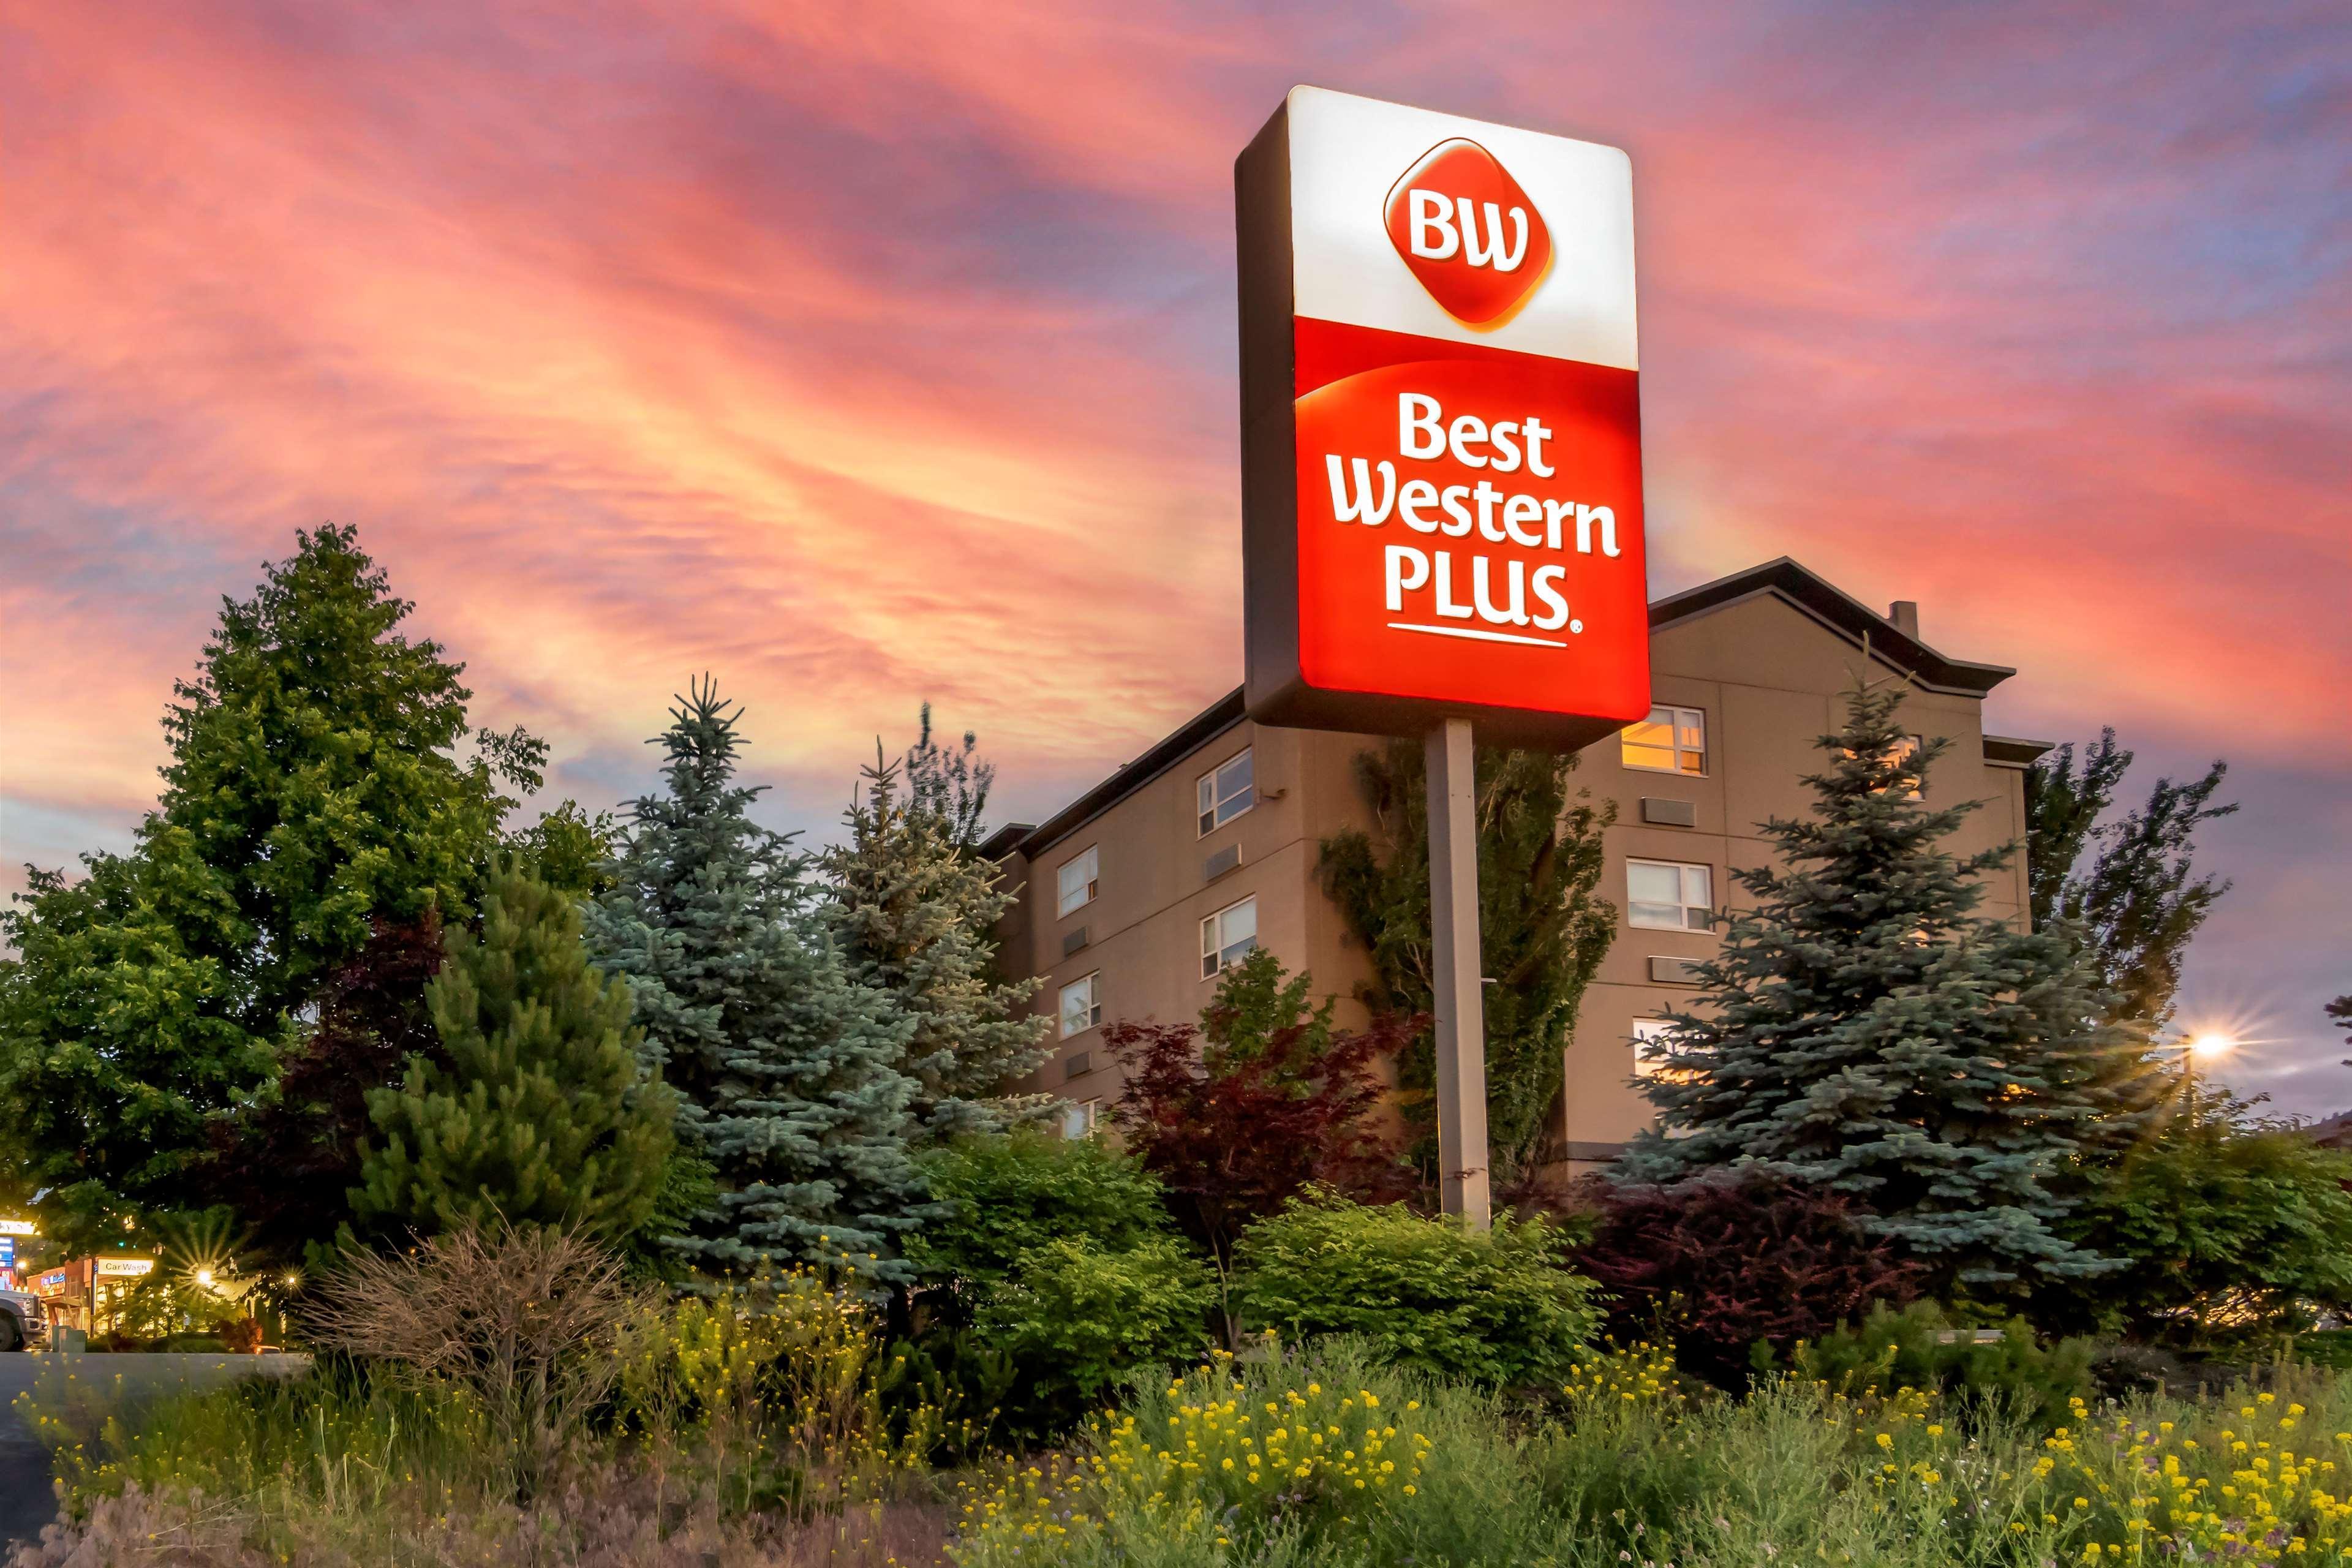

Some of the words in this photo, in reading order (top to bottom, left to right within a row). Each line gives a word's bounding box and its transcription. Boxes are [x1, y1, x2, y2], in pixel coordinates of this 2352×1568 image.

[1408, 188, 1529, 272] BW
[1398, 392, 1555, 478] Best
[1325, 453, 1621, 557] Western
